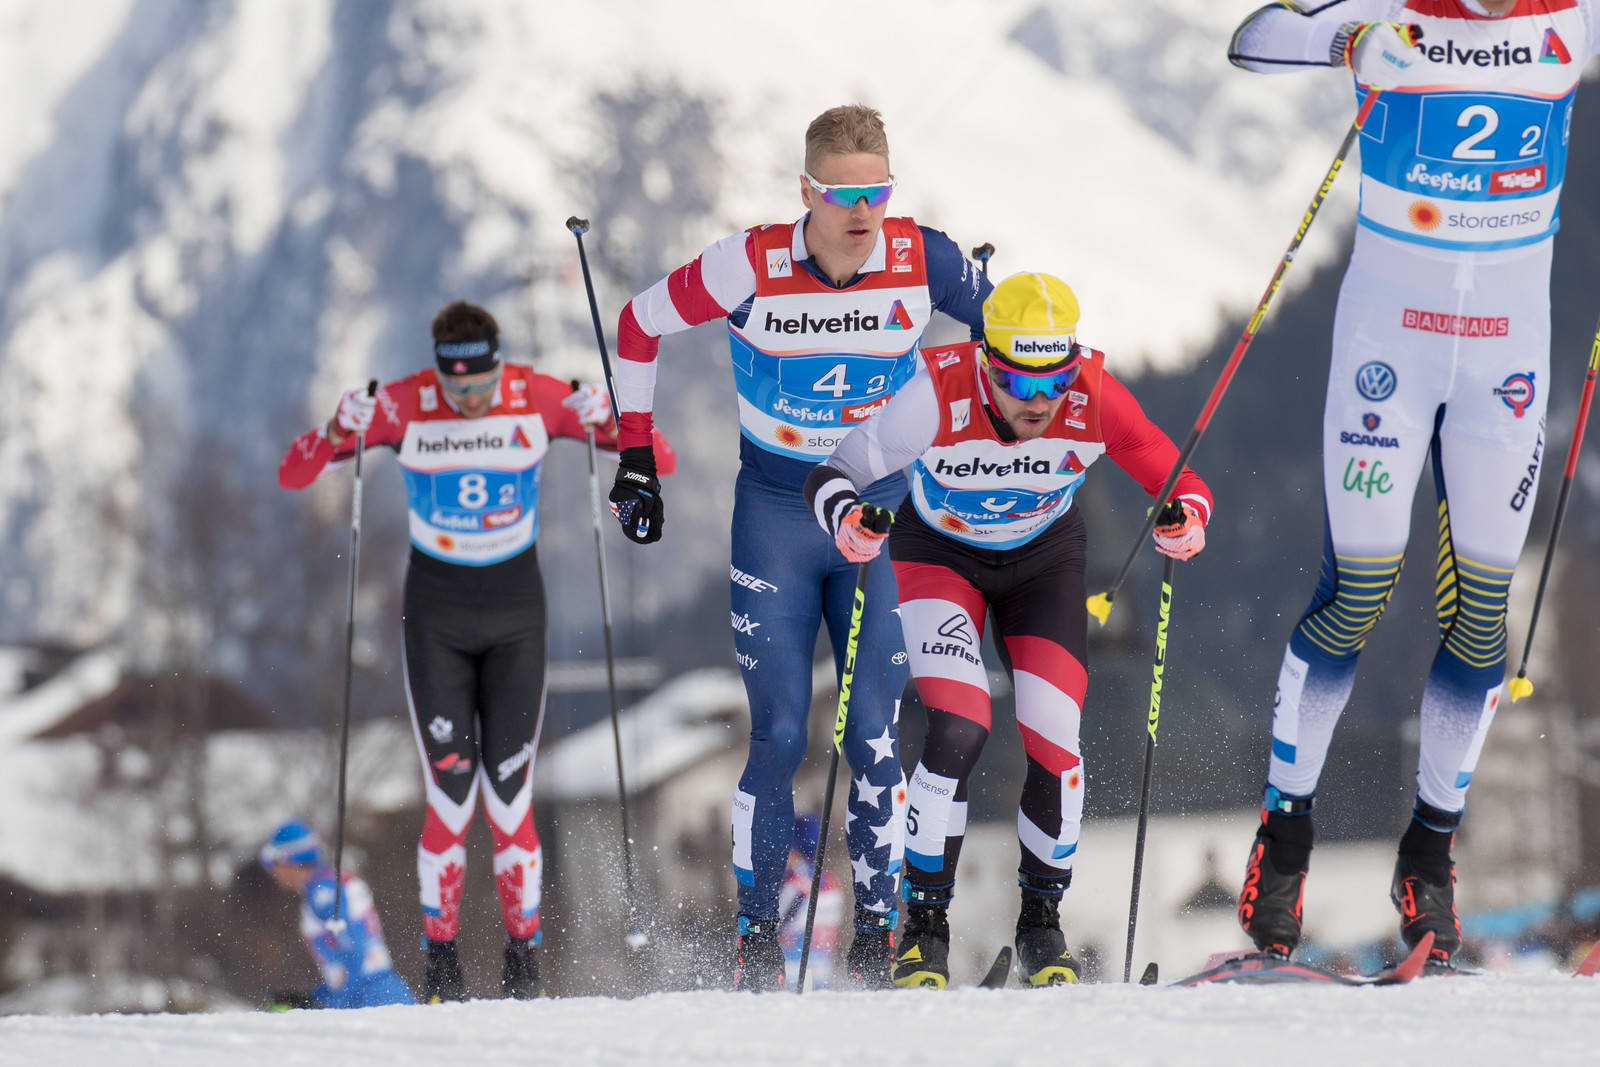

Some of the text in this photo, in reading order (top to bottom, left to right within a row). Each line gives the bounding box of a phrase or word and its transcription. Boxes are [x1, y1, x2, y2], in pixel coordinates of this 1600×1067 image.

[1451, 105, 1541, 160] 2 2
[1405, 163, 1541, 192] Seefeld Tirol
[1448, 210, 1541, 229] storaenso
[764, 309, 879, 335] helvetia
[1403, 309, 1508, 336] BAUHAUS
[1014, 340, 1067, 353] helvetia
[812, 363, 886, 398] 4 2
[1493, 387, 1527, 397] Thermia
[773, 398, 835, 422] Seefeld
[417, 433, 504, 454] helvetia
[1340, 431, 1400, 448] SCANIA
[935, 456, 1051, 478] helvetia
[1343, 456, 1394, 499] life
[1510, 433, 1544, 513] CRAFT
[457, 473, 516, 510] 8 2
[730, 564, 778, 593] OSE
[922, 642, 981, 666] Löffler
[906, 804, 920, 836] 5
